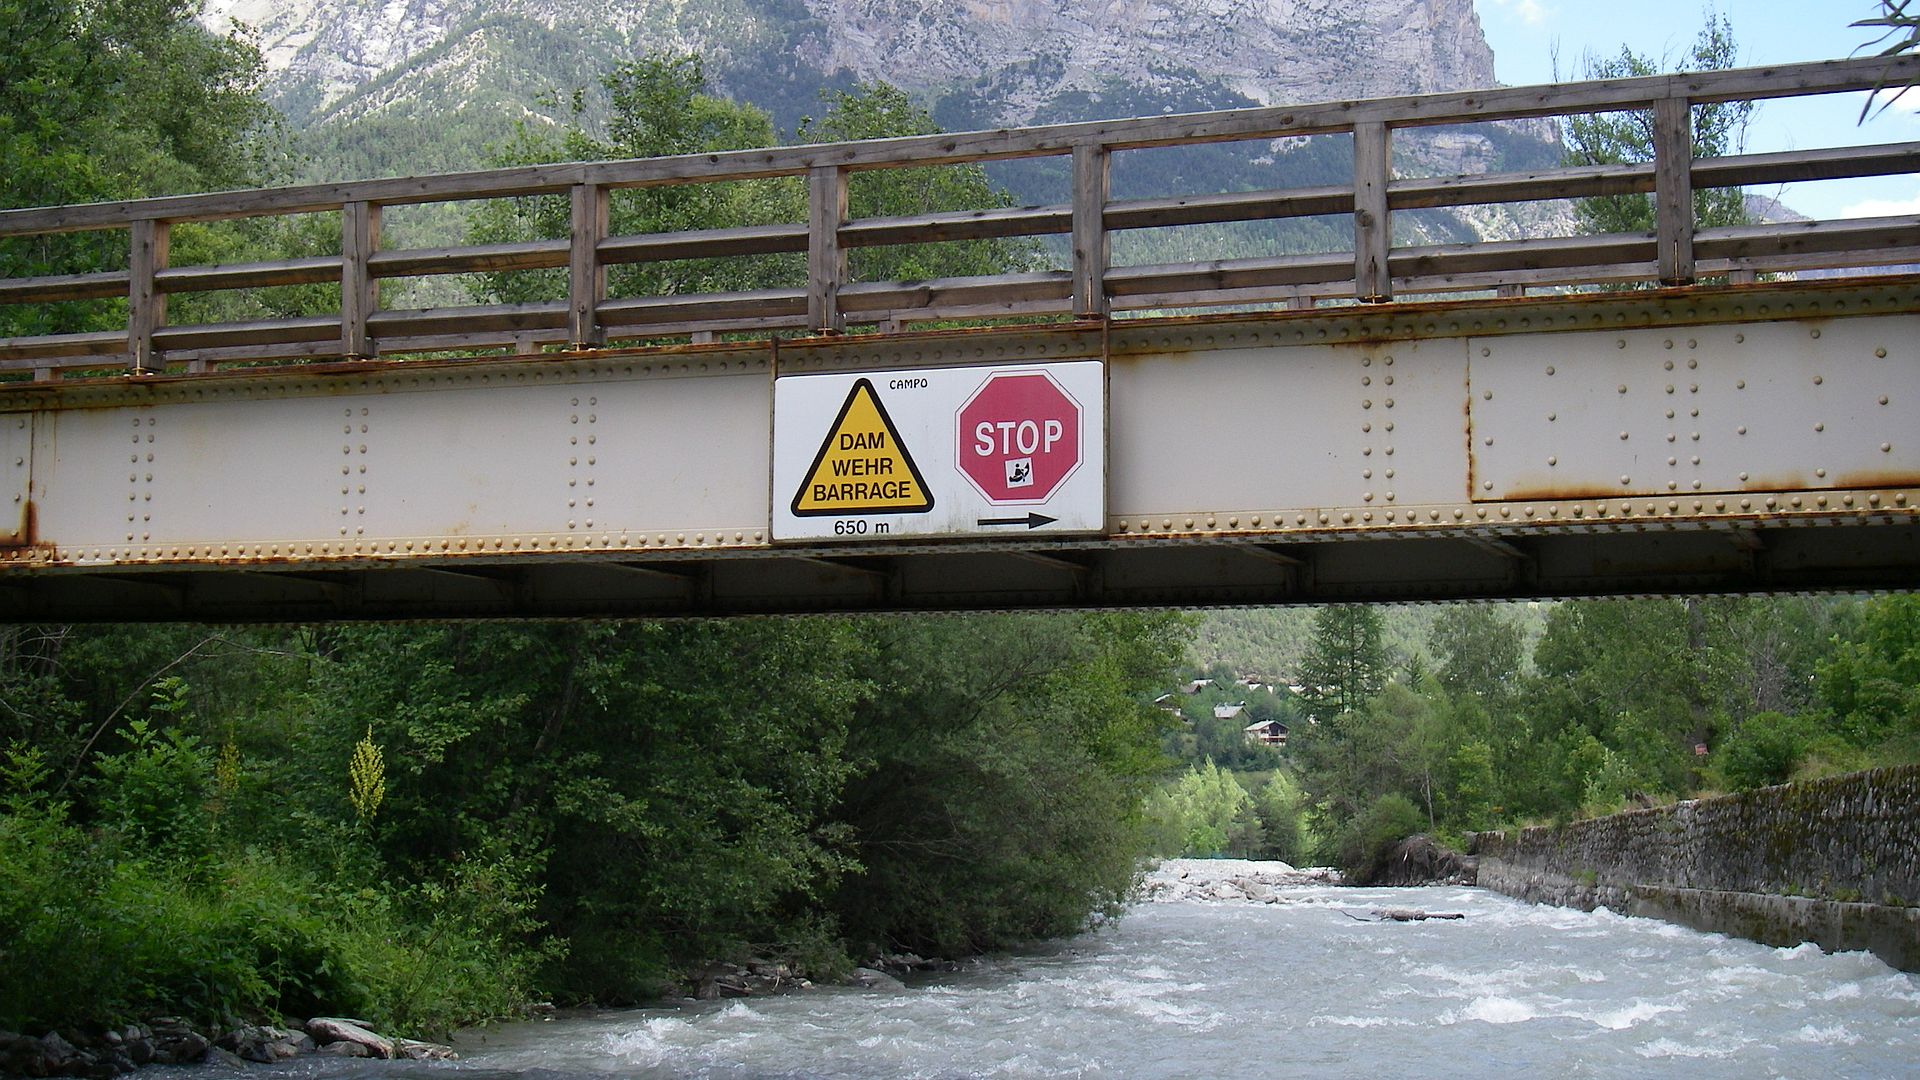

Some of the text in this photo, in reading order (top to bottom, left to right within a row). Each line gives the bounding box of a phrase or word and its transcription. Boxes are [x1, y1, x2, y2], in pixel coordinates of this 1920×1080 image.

[889, 378, 928, 390] CAMPO
[840, 432, 885, 451] DAM
[974, 420, 1063, 457] STOP
[832, 458, 893, 477] WEHR
[813, 481, 911, 502] BARRAGE
[834, 519, 890, 535] 650 m
